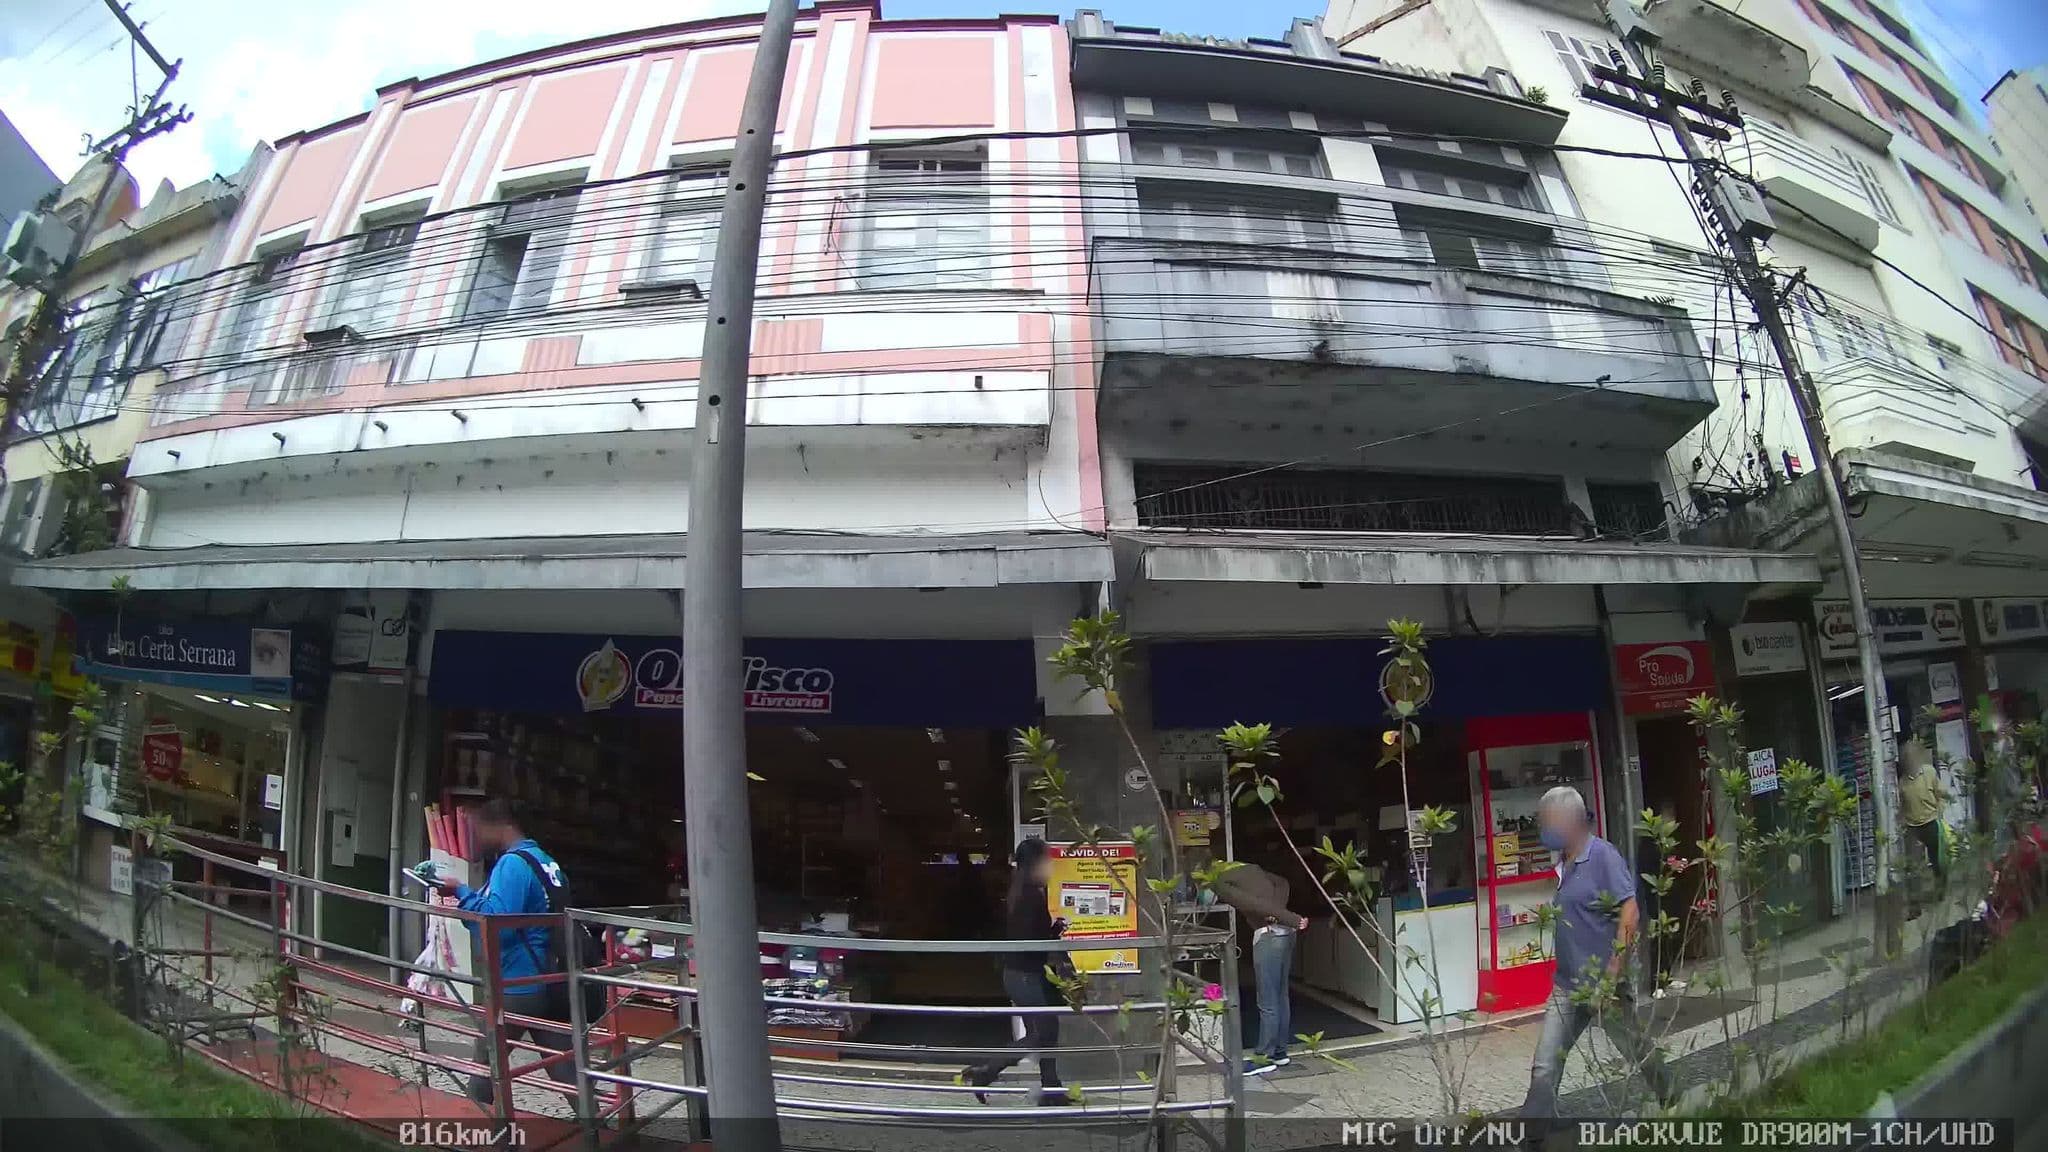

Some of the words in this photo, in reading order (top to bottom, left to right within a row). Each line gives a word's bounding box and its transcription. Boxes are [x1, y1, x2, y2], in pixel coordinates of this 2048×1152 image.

[139, 634, 175, 661] Certa
[179, 638, 236, 667] Serrana
[751, 692, 825, 708] Livraria
